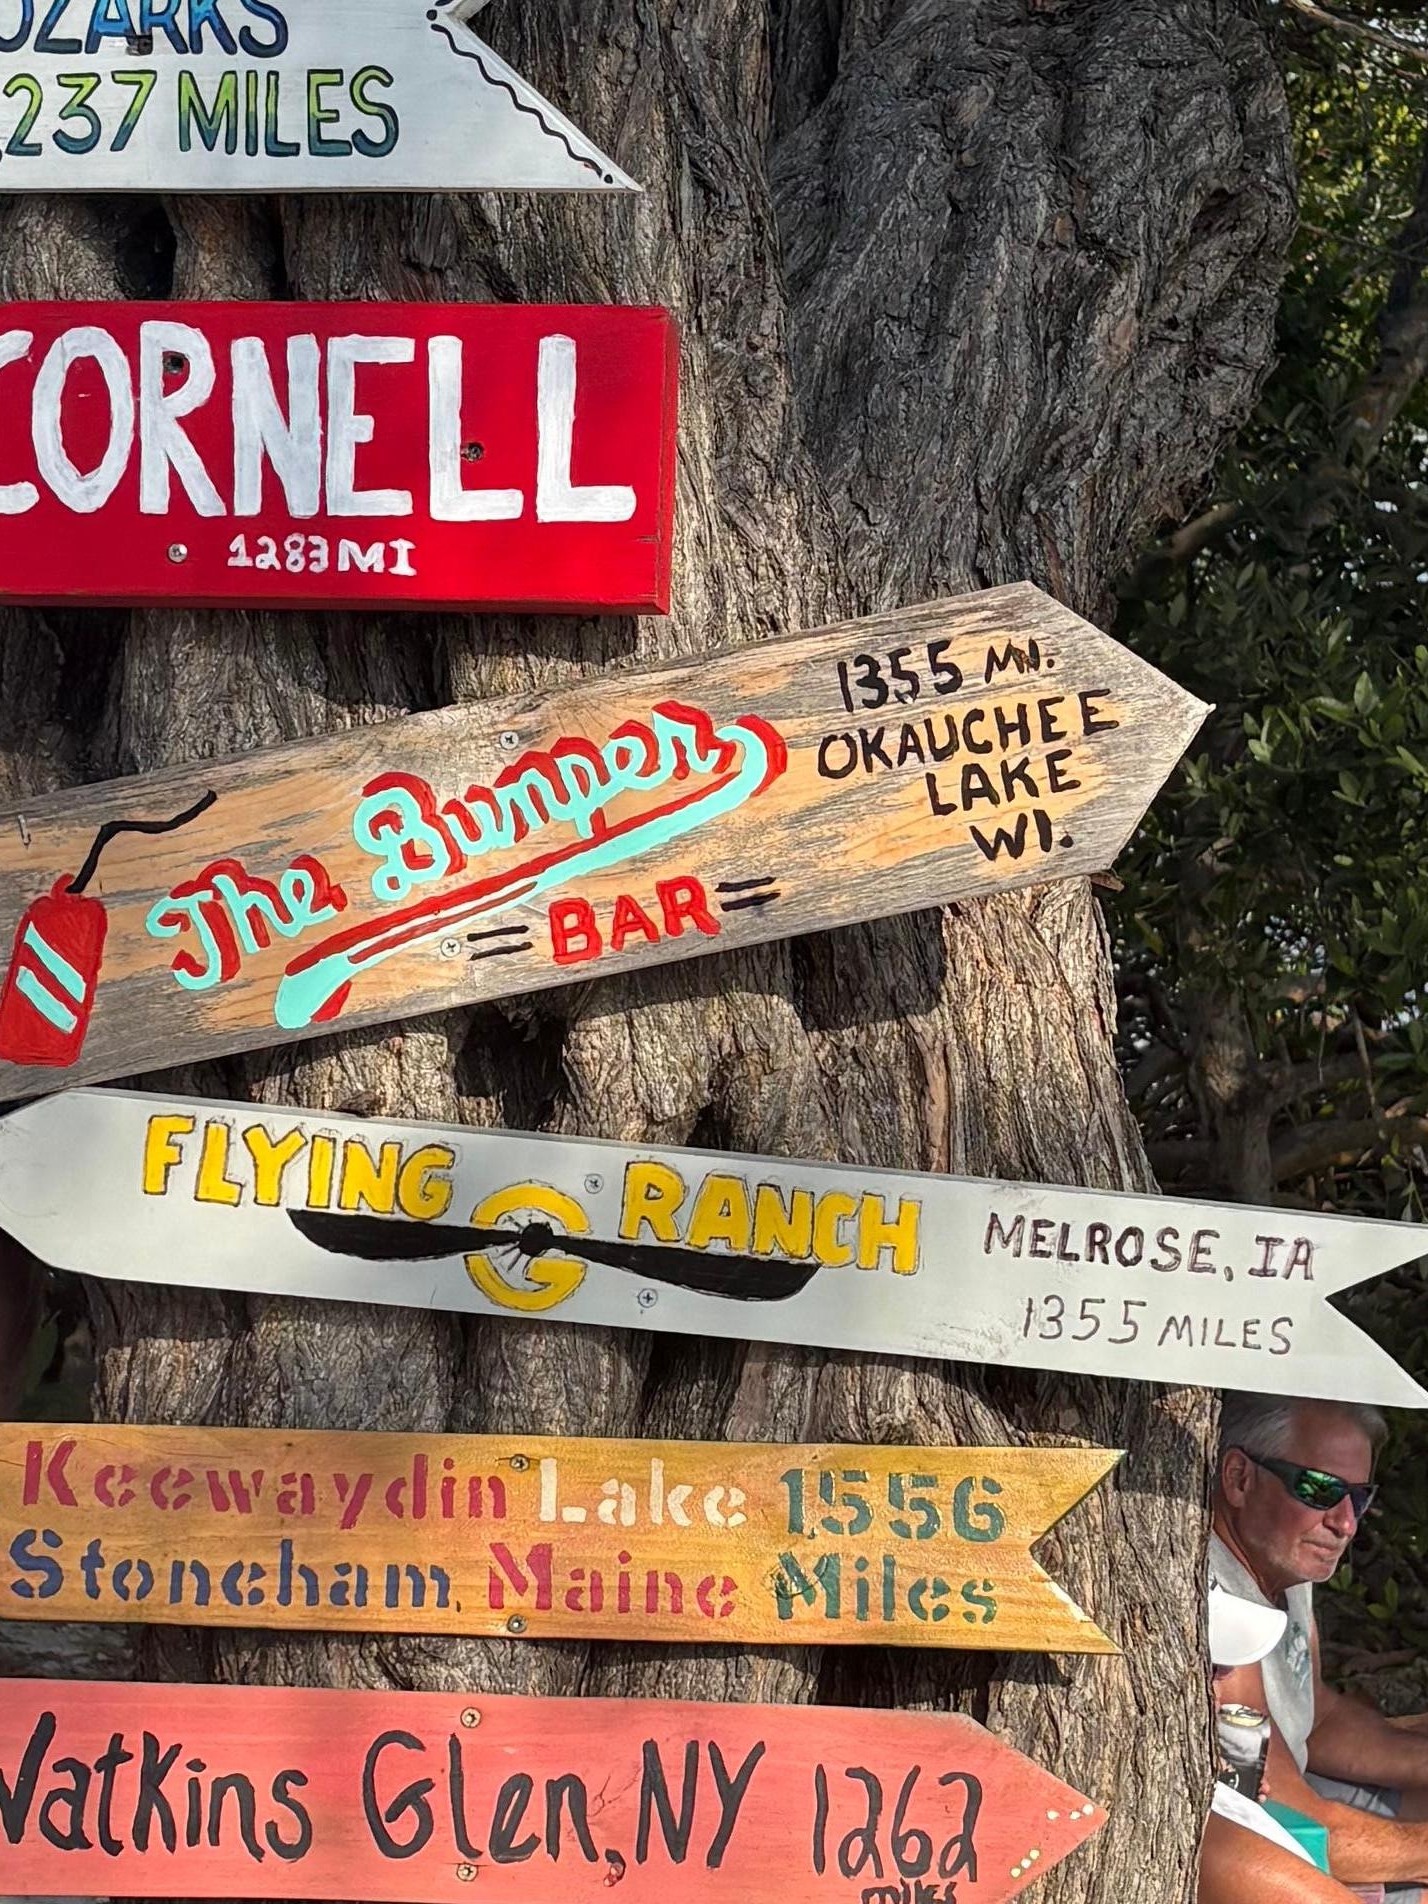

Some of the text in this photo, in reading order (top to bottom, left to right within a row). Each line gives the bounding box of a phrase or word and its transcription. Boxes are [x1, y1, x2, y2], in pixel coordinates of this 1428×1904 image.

[178, 64, 401, 158] MILES
[836, 639, 964, 713] 1355
[817, 688, 1120, 779] OKAUCHEE
[925, 748, 1082, 816] LAKE
[968, 809, 1074, 862] WI.
[146, 854, 348, 991] The
[547, 874, 723, 967] BAR
[142, 1113, 457, 1221] FLYING
[618, 1158, 924, 1276] RANCH
[983, 1211, 1315, 1282] MELROSE, IA
[1023, 1293, 1293, 1356] 1355 MILES
[23, 1439, 507, 1530] Keewaydin
[538, 1457, 748, 1528] Lake
[488, 1541, 738, 1619] Maine
[773, 1549, 999, 1623] Miles
[813, 1763, 984, 1883] 1262
